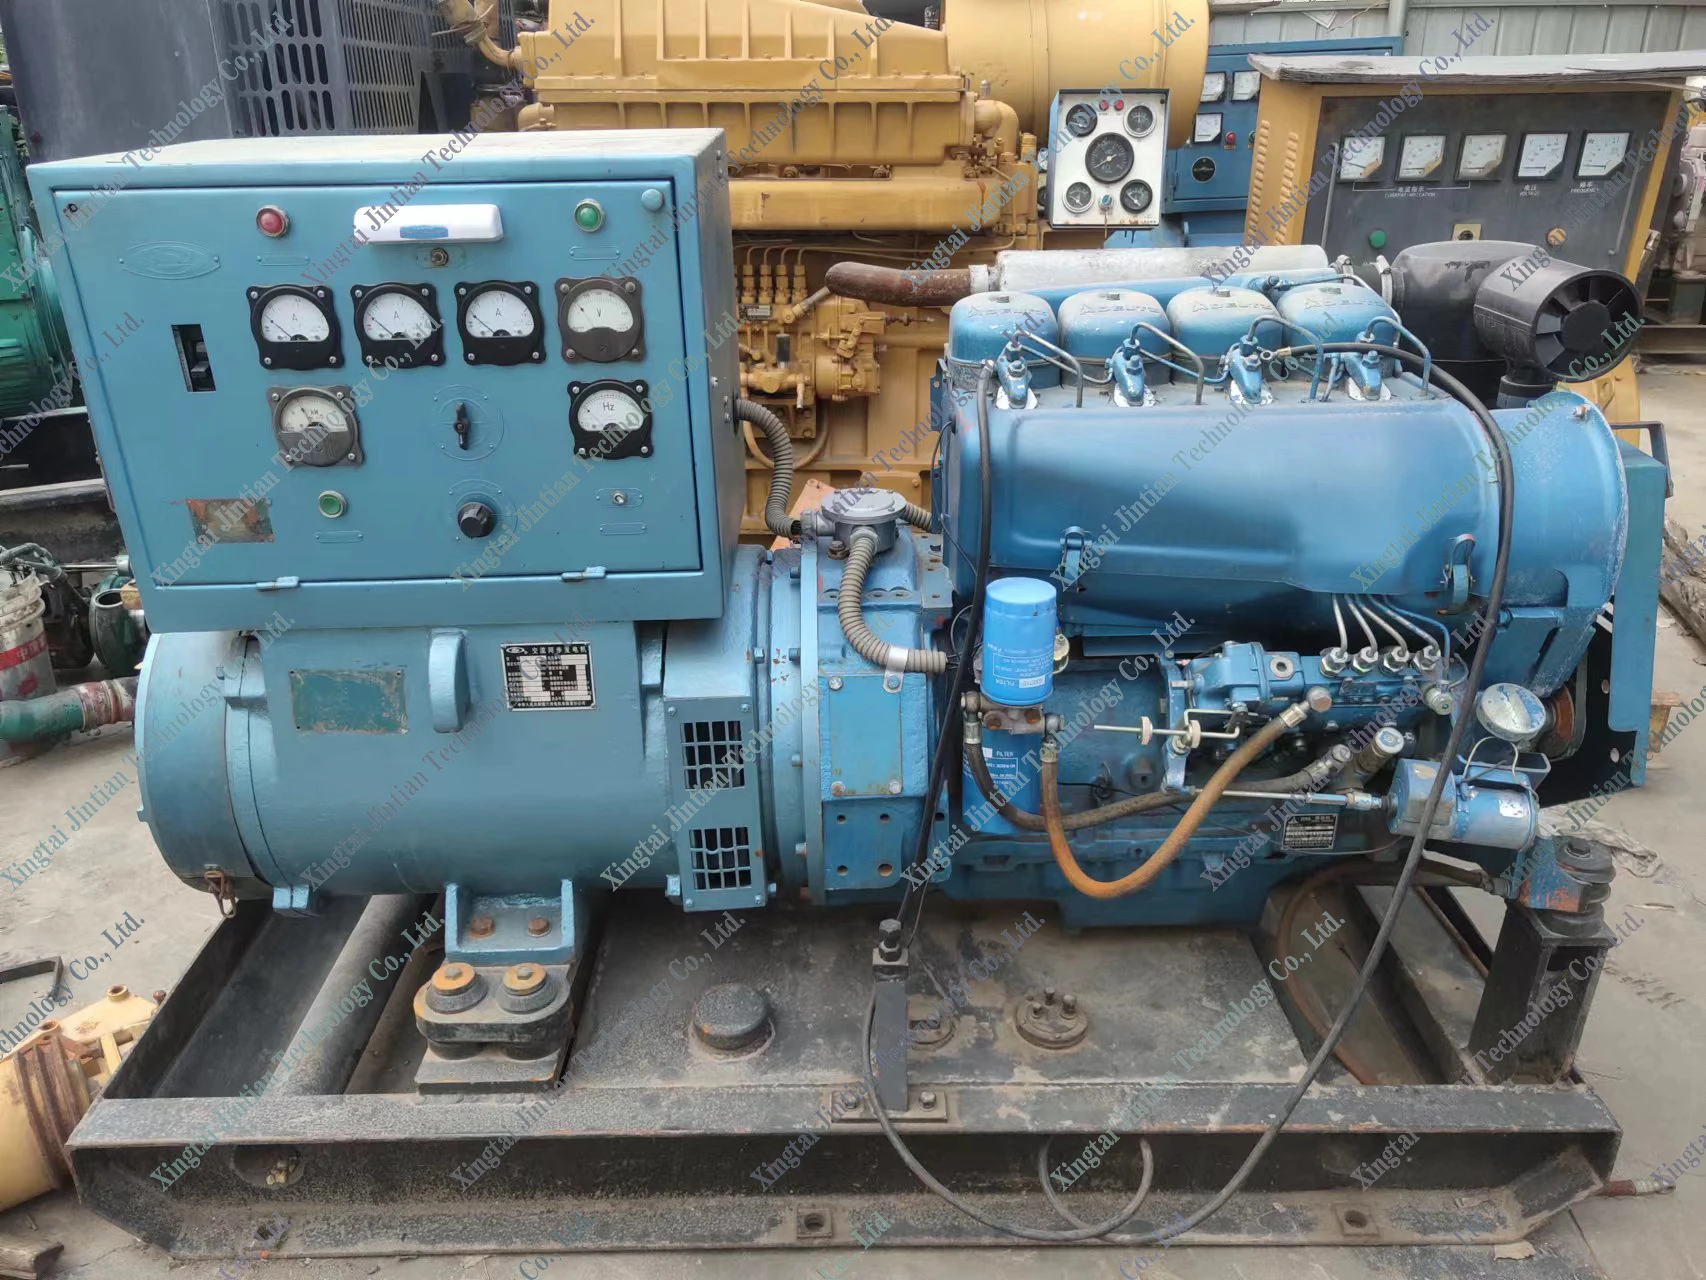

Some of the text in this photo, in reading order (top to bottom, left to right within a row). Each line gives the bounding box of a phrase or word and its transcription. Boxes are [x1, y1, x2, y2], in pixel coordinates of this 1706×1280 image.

[292, 312, 298, 320] A
[394, 310, 400, 320] A
[496, 308, 502, 316] A
[602, 402, 615, 411] Hz
